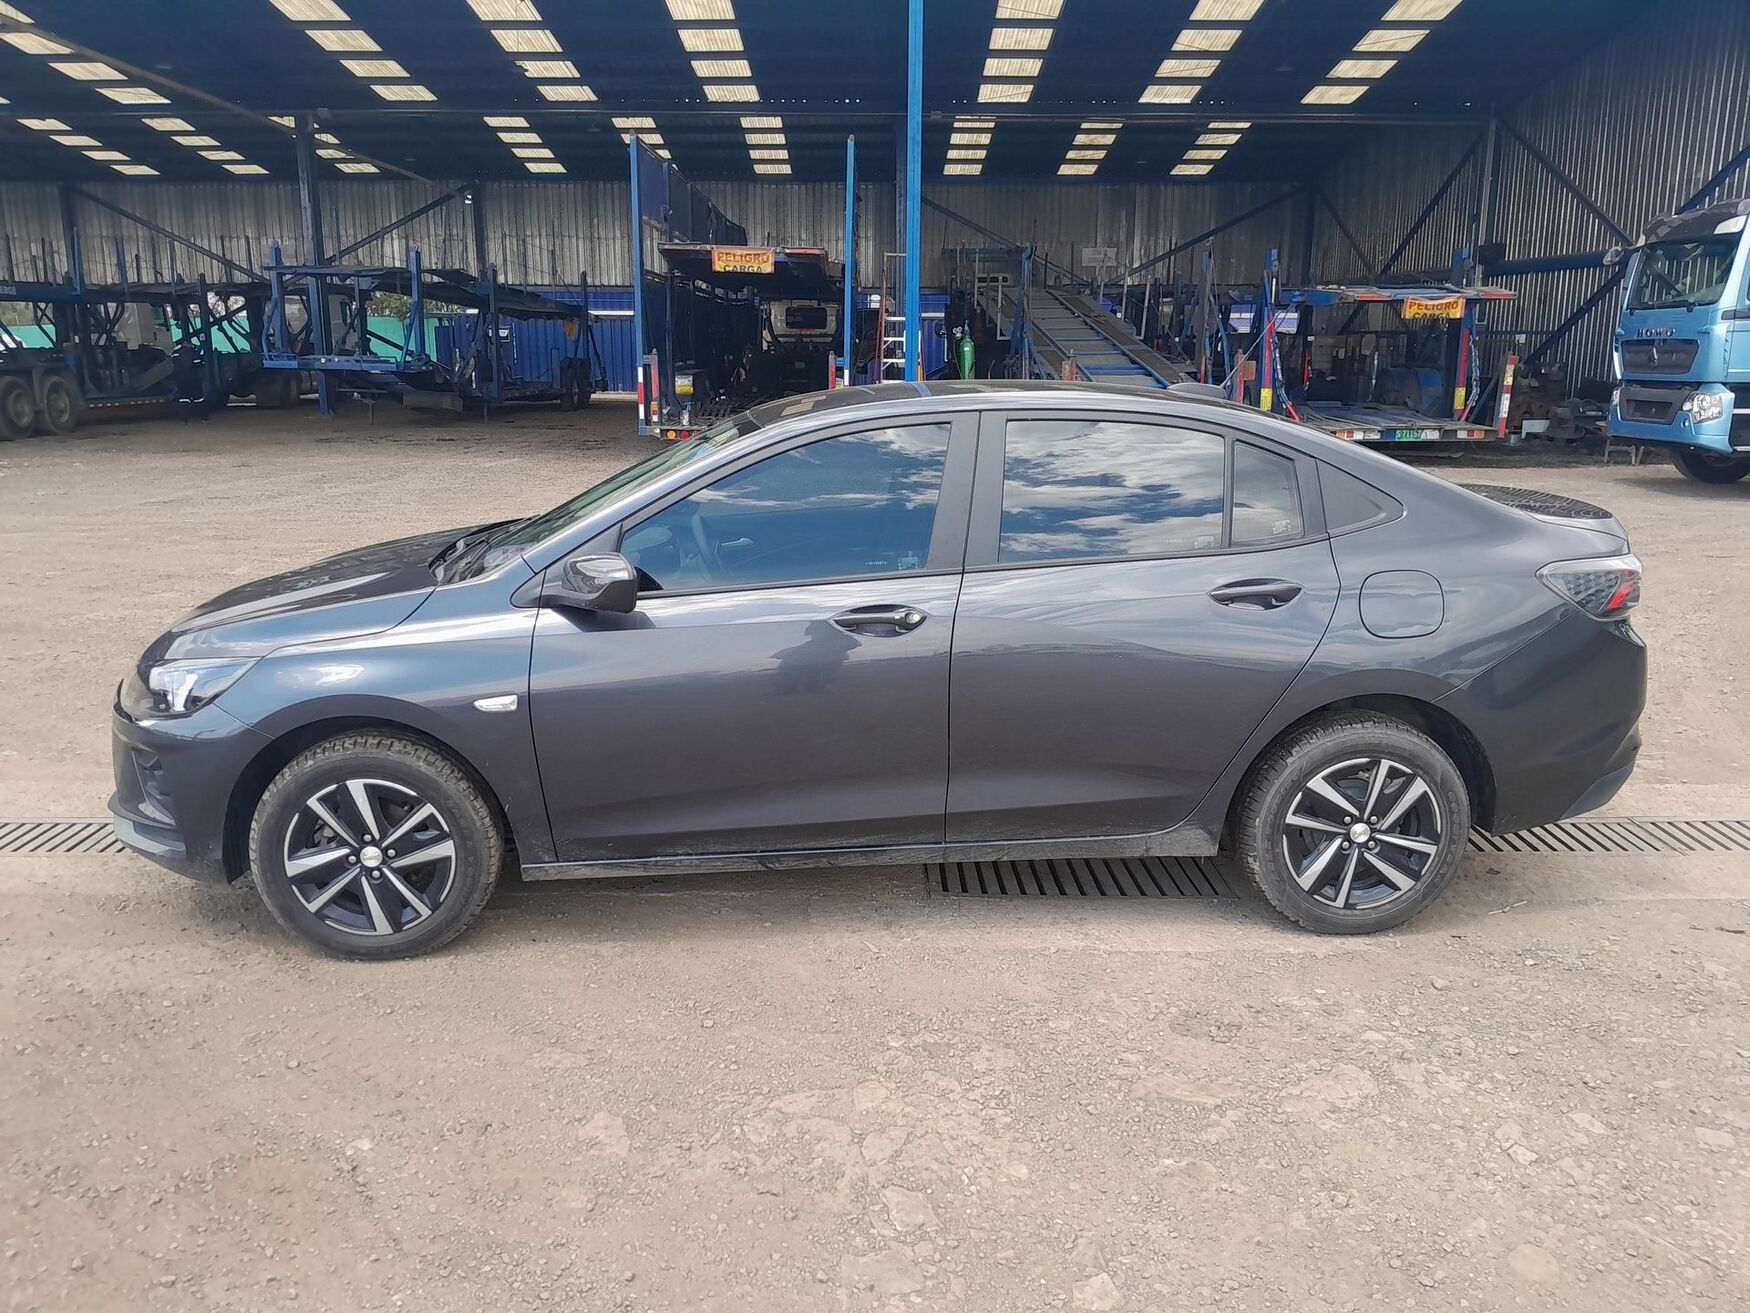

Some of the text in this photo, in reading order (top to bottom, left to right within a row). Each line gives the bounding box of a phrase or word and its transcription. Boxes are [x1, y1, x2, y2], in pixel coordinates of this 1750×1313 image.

[717, 251, 770, 264] PELIGRO
[723, 264, 764, 273] CARGA
[1408, 301, 1459, 311] PELIGRO
[1637, 328, 1676, 338] HOWO
